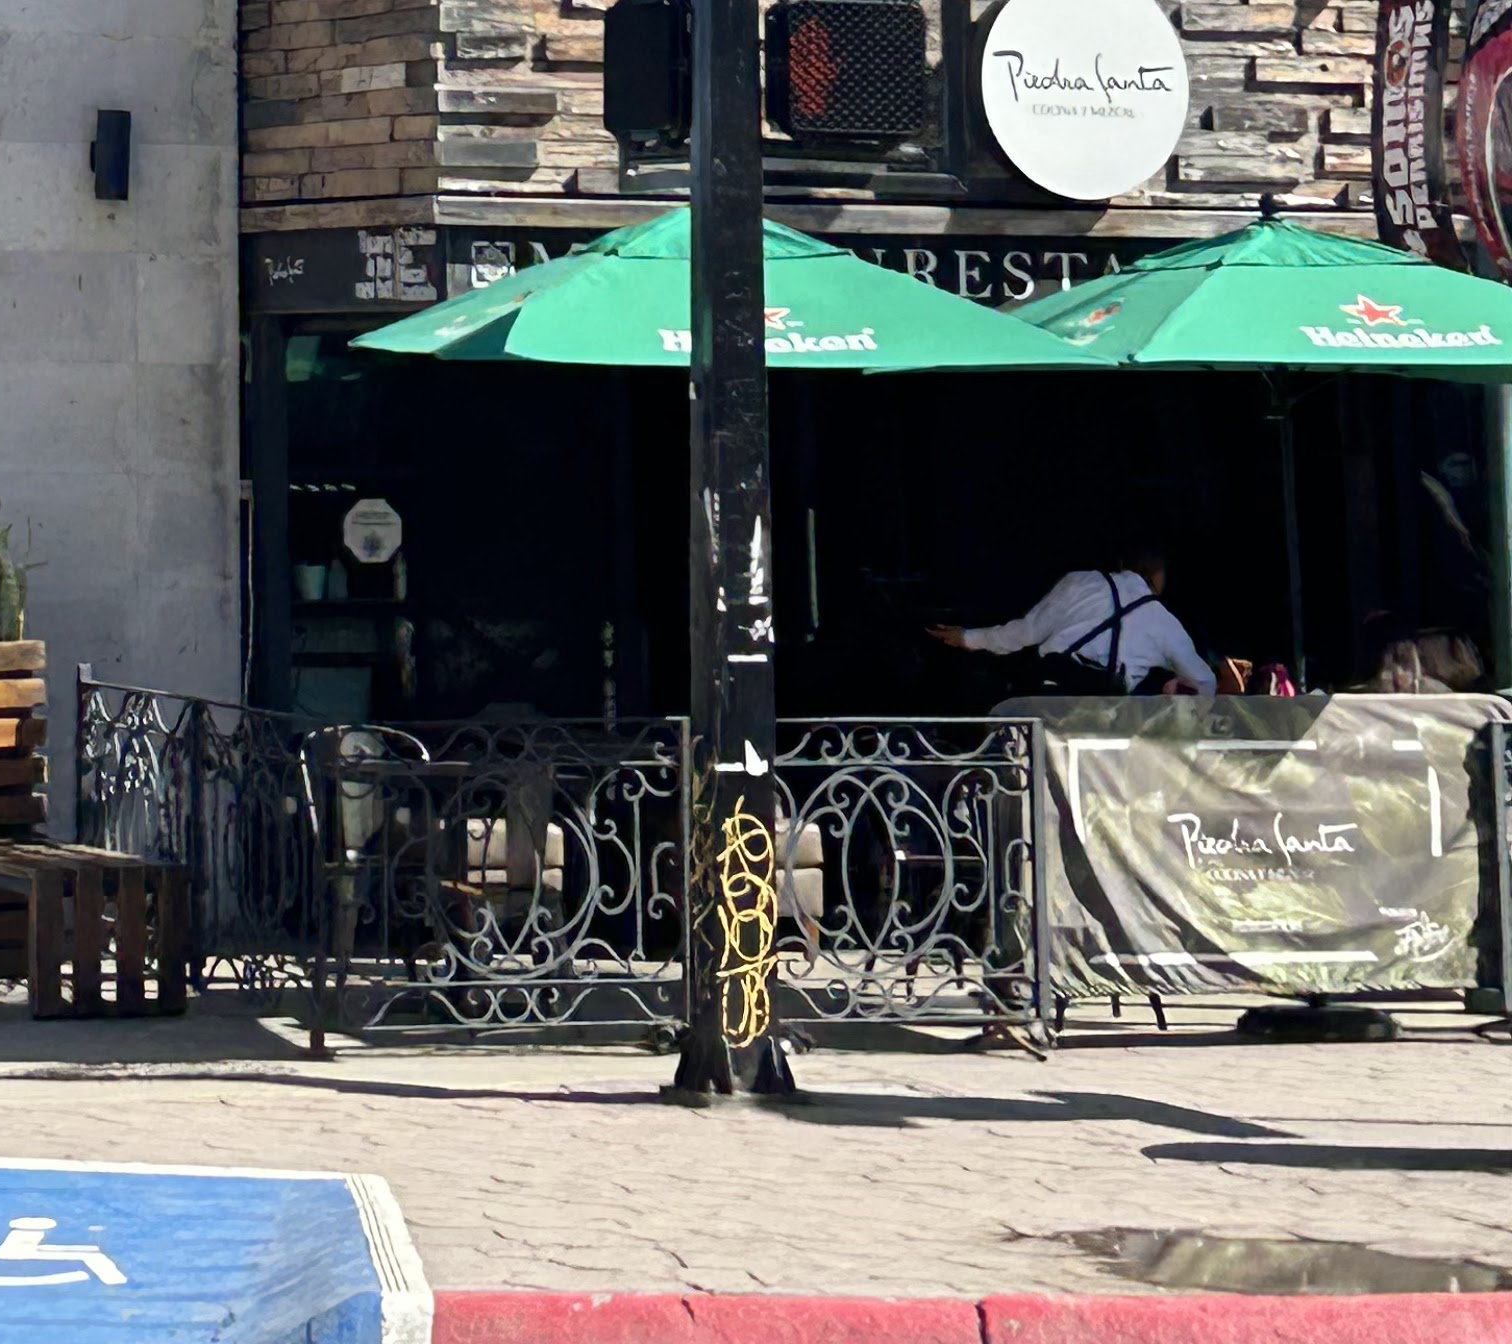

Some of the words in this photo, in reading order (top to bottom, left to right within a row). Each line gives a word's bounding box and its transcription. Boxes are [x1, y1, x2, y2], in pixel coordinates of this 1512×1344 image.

[992, 50, 1095, 102] Piedra
[1094, 52, 1175, 104] Santa
[657, 328, 878, 353] Heken
[1298, 324, 1504, 348] Heineken
[1166, 812, 1273, 870] Piedra
[1273, 812, 1358, 867] Santa
